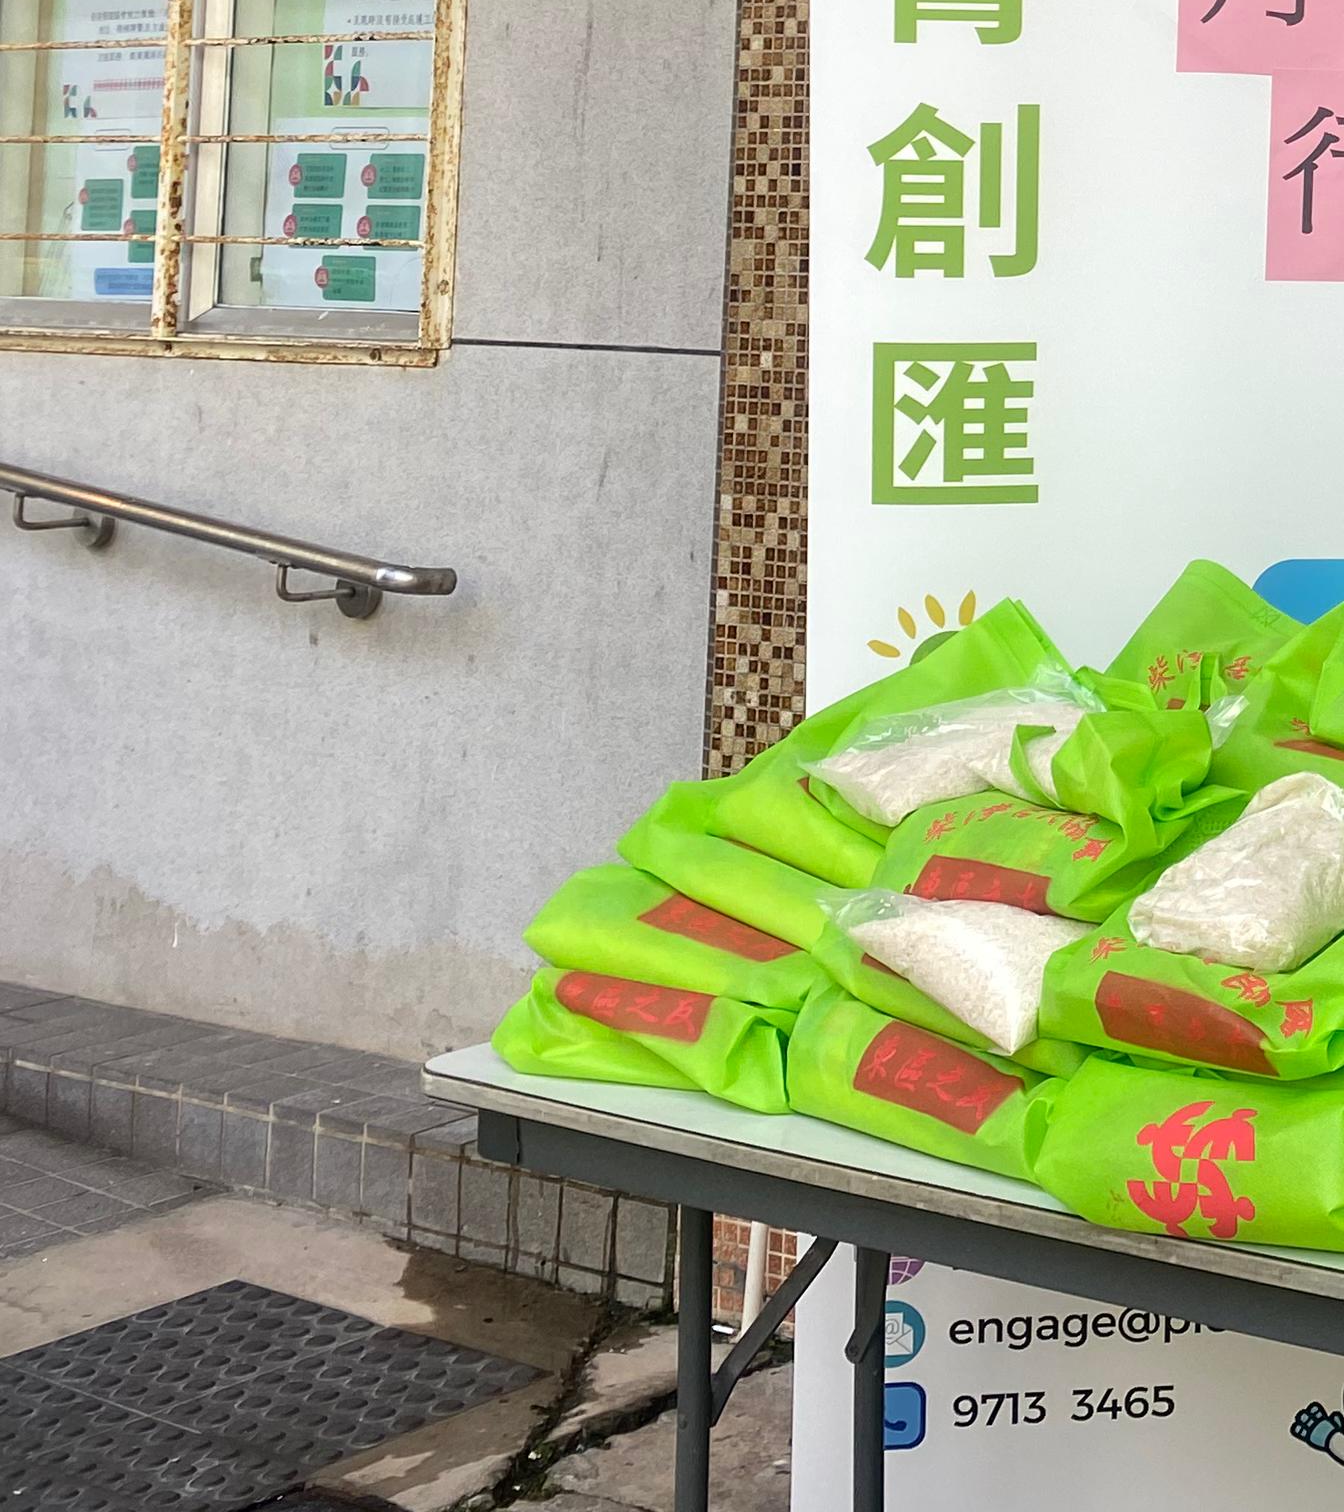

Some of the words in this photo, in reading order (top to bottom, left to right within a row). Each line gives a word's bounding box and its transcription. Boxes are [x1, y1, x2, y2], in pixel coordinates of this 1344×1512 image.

[949, 1306, 1227, 1350] engage@p
[952, 1391, 1047, 1428] 9713
[1070, 1385, 1176, 1422] 3465
